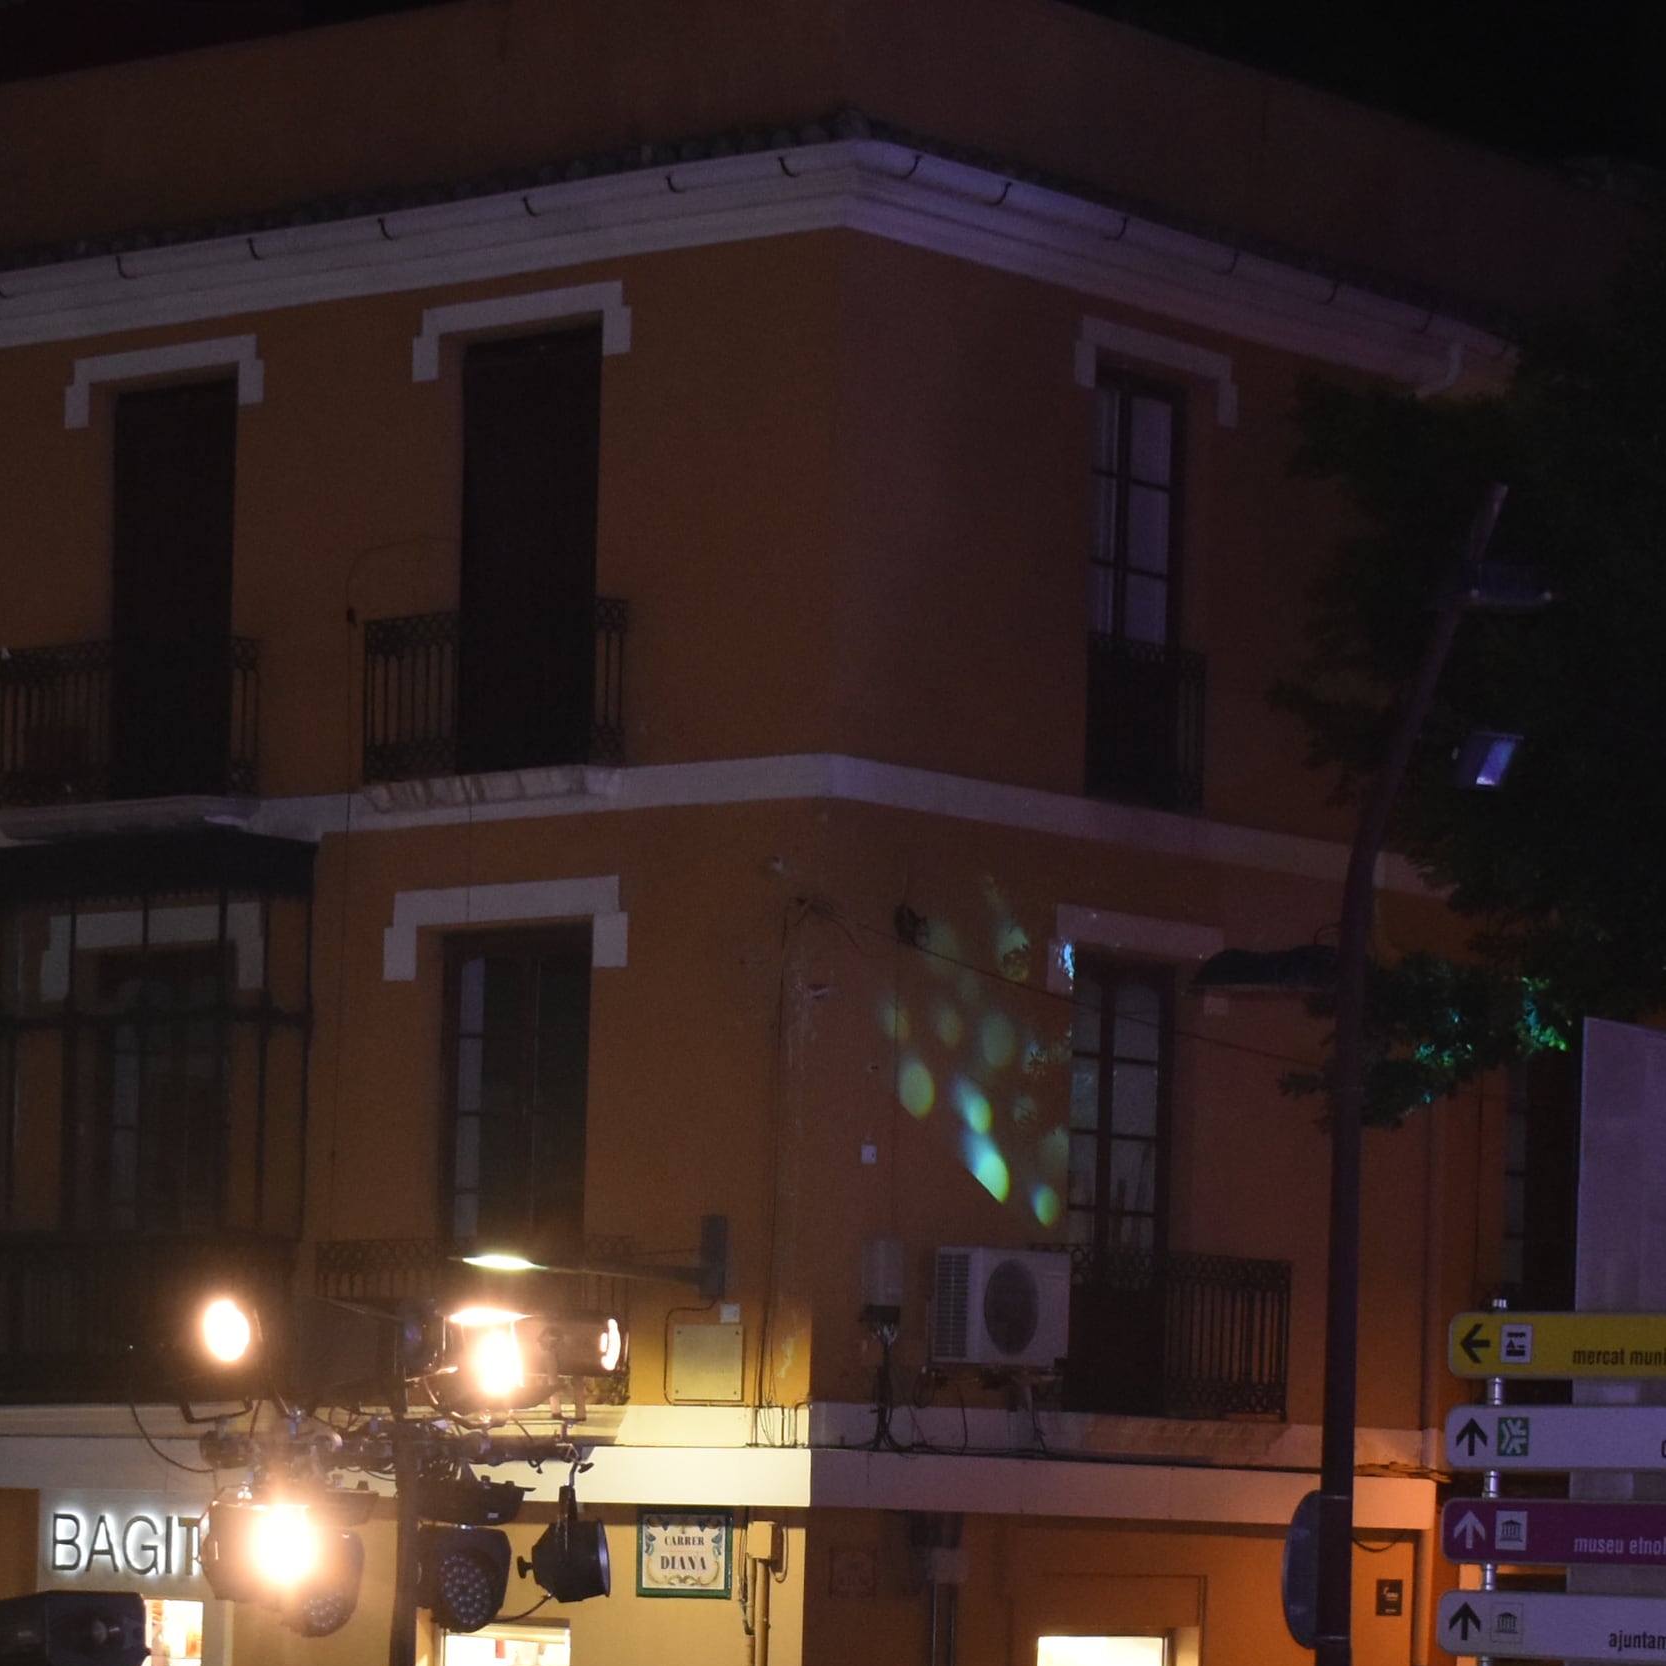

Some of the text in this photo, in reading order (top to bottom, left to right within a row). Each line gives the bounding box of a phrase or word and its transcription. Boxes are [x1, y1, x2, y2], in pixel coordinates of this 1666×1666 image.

[1572, 1349, 1624, 1366] mercat
[664, 1536, 705, 1546] CARRER
[1574, 1537, 1624, 1554] museu
[660, 1555, 707, 1570] DIANA
